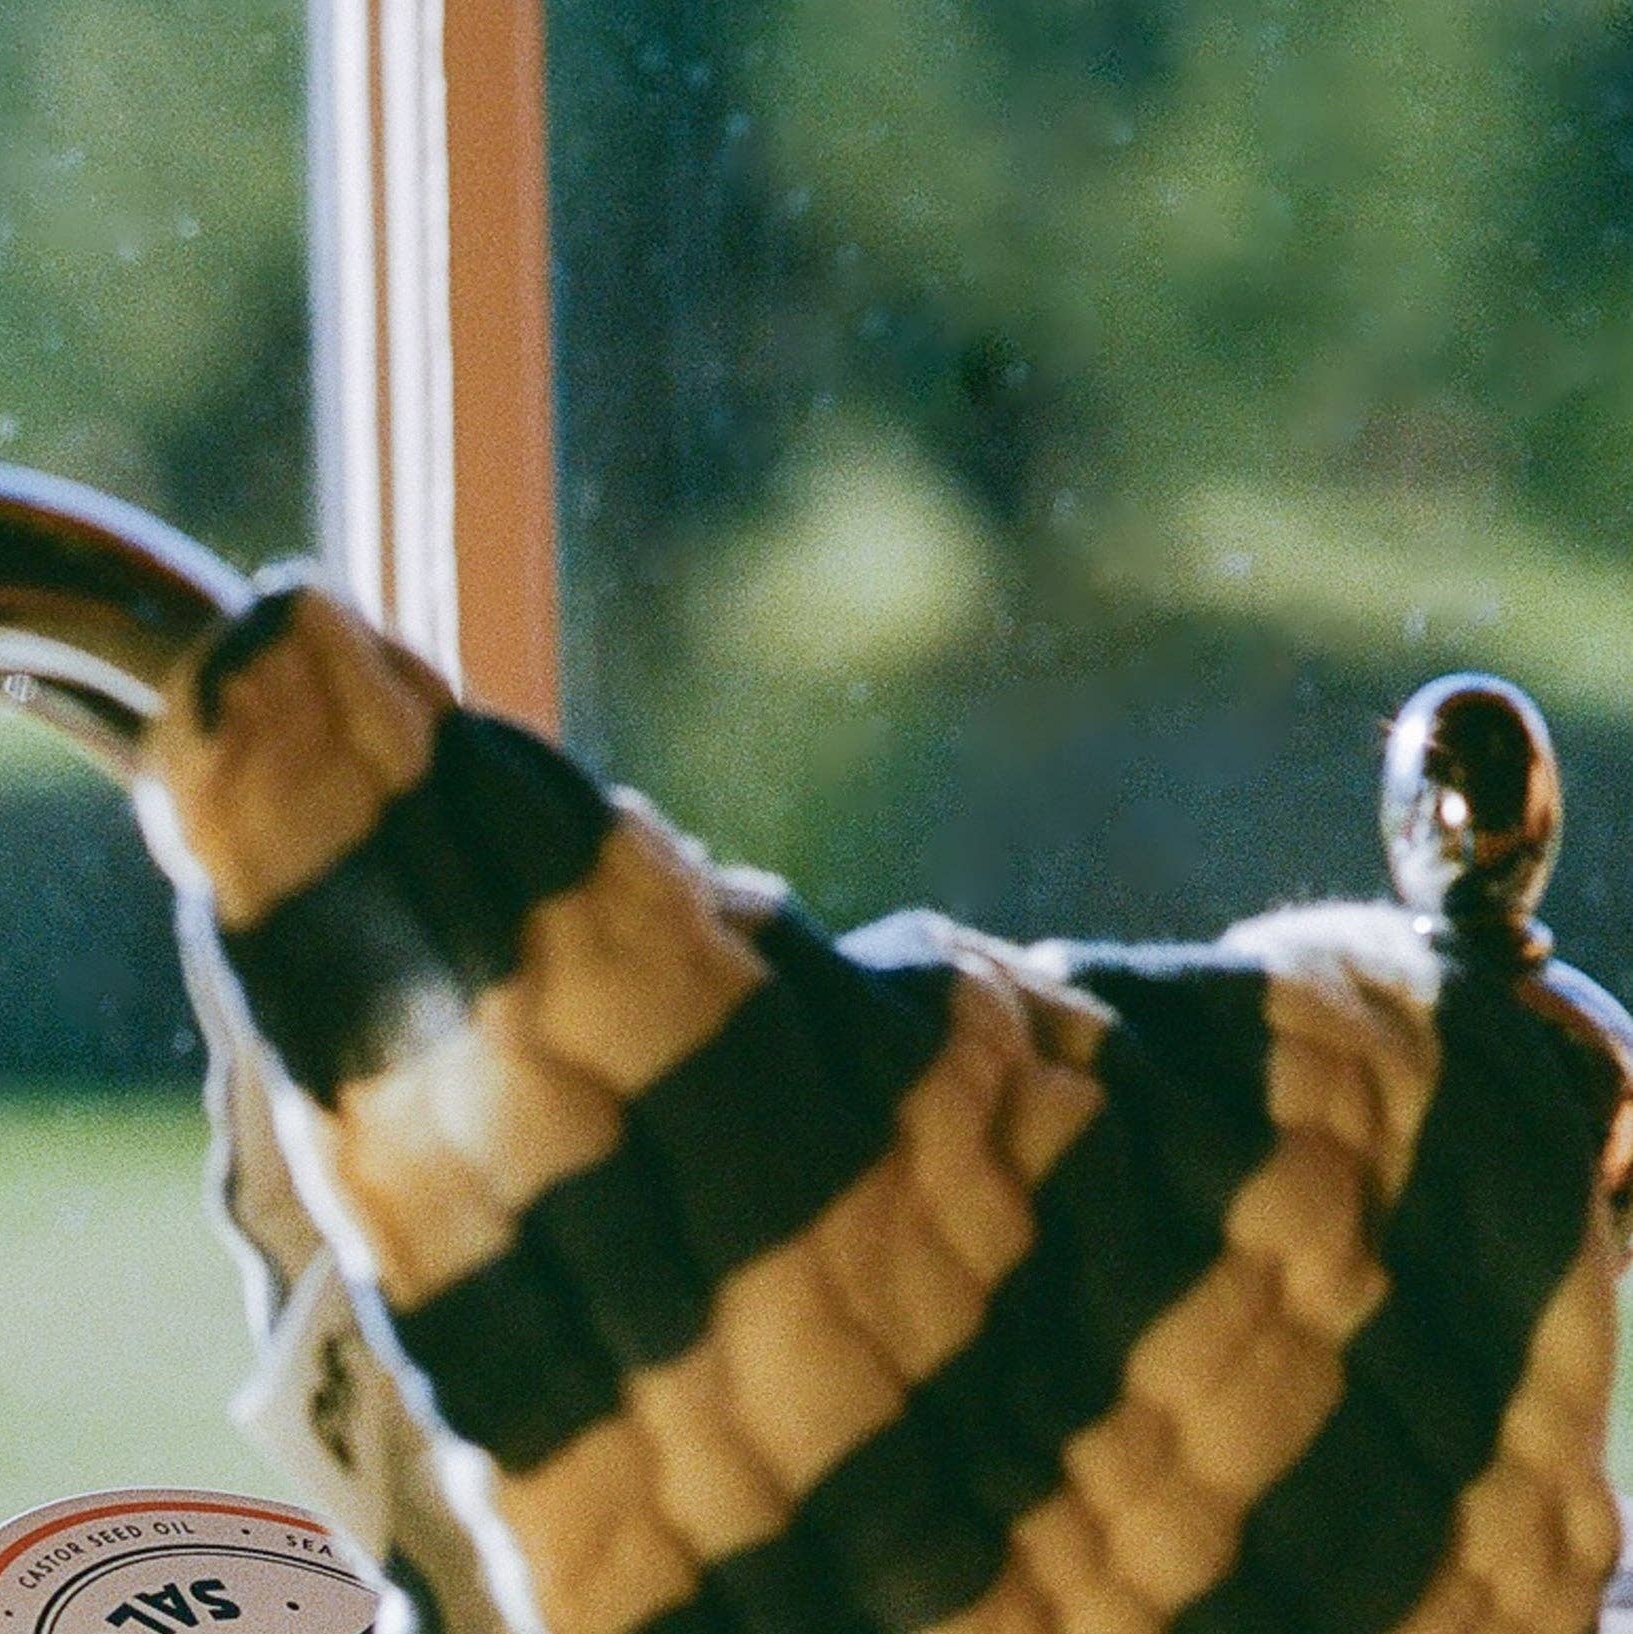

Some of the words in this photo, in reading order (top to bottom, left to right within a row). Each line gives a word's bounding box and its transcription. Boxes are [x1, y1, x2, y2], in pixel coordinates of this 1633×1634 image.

[19, 1541, 85, 1589] CASTOR
[87, 1525, 143, 1548] SEED
[153, 1521, 195, 1536] OIL
[286, 1534, 333, 1558] SEA
